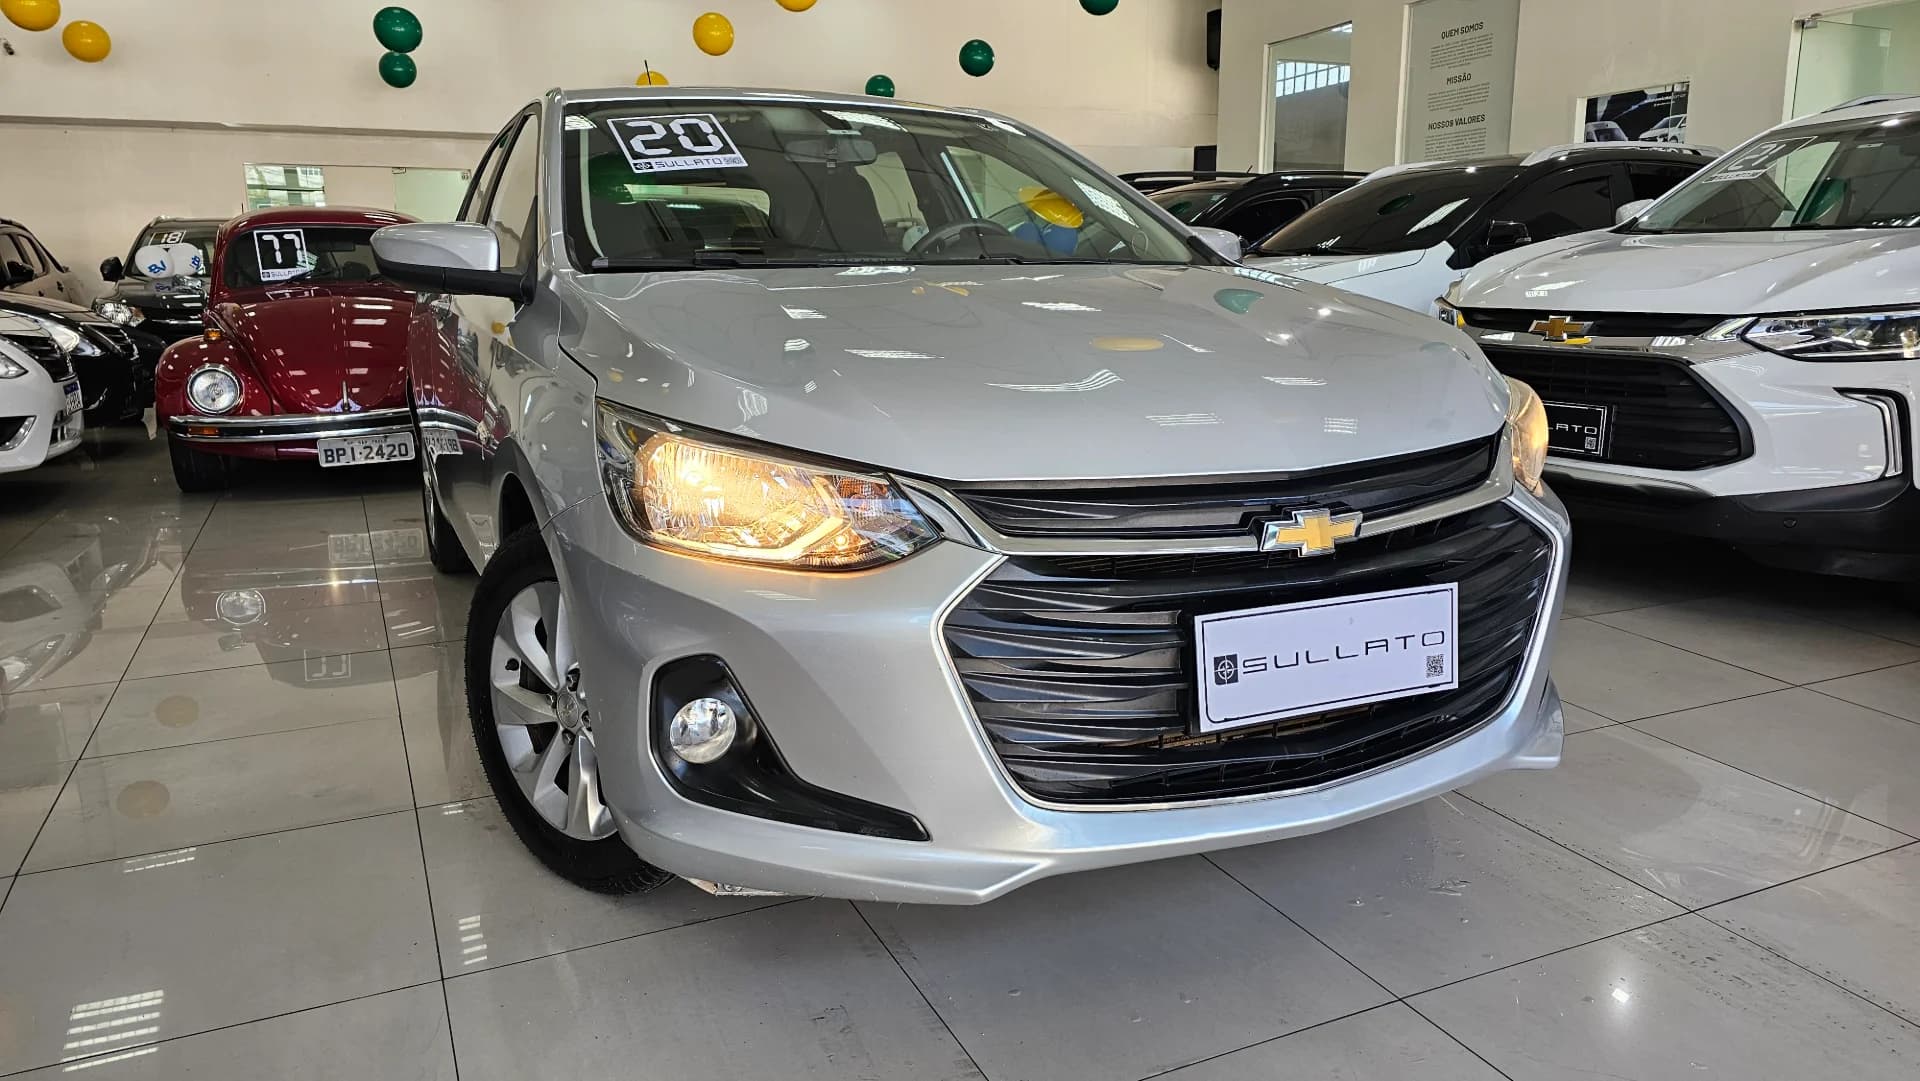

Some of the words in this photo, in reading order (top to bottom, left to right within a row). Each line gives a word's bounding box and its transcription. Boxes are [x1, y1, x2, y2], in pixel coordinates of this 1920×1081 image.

[1441, 26, 1460, 40] QUEM
[1460, 21, 1484, 34] SOMOS
[1446, 72, 1472, 85] MISSÃO
[1428, 119, 1454, 131] NOSSOS
[1454, 114, 1486, 127] VALORES
[625, 118, 724, 156] 20
[655, 157, 722, 168] SULLATO
[262, 233, 303, 264] 77
[1242, 630, 1445, 675] SULLATO
